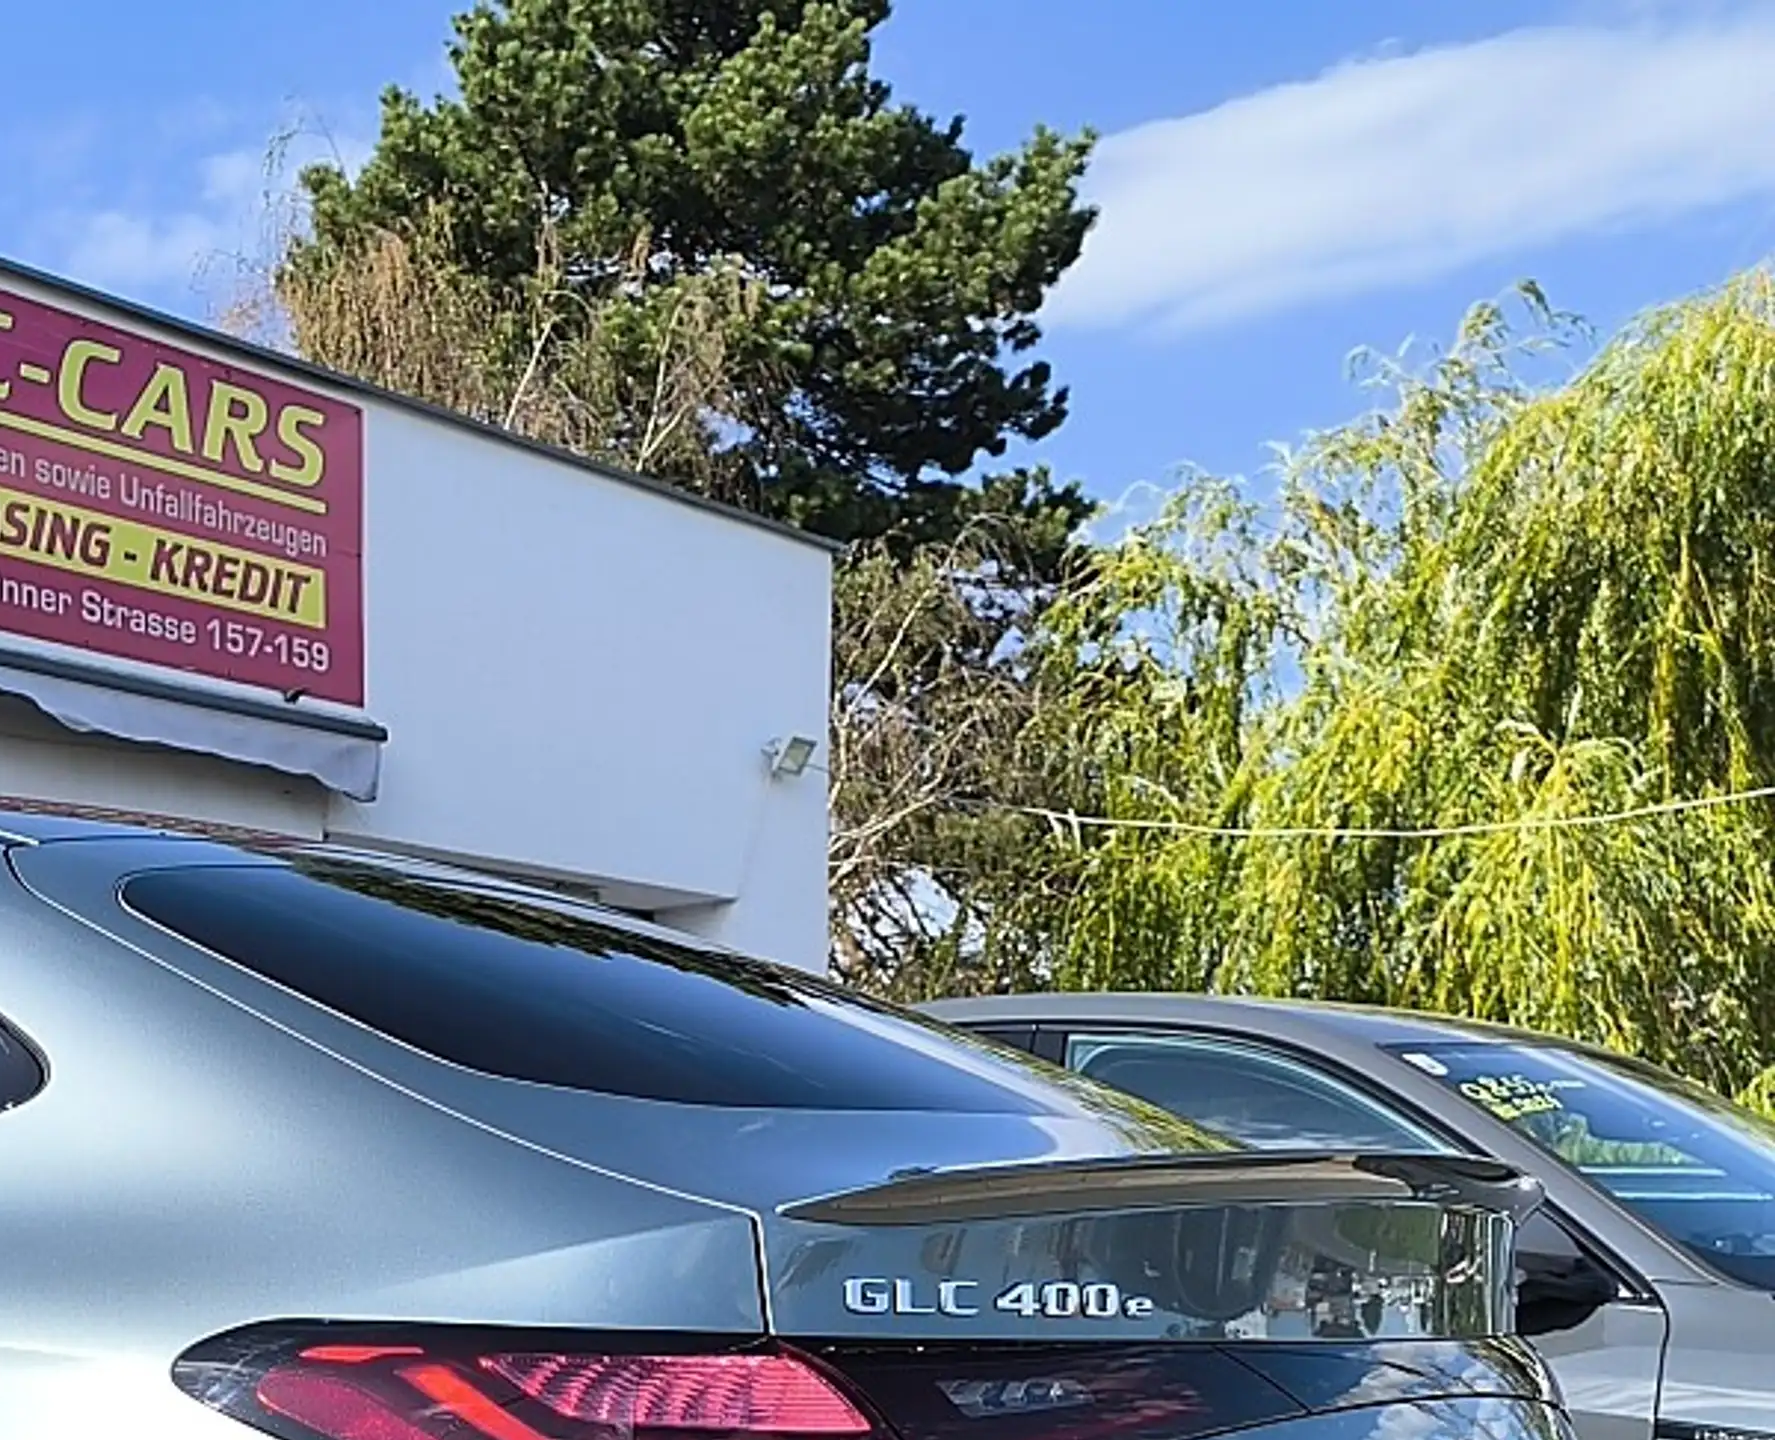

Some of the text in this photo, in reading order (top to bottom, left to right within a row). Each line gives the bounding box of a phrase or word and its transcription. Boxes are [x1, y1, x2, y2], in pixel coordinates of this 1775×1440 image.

[35, 464, 111, 500] sowie
[120, 474, 326, 557] Unfallfahrzeugen
[150, 538, 312, 614] KREDIT
[81, 590, 196, 644] Strasse
[207, 618, 329, 672] 157-159
[843, 1277, 979, 1316] GLC
